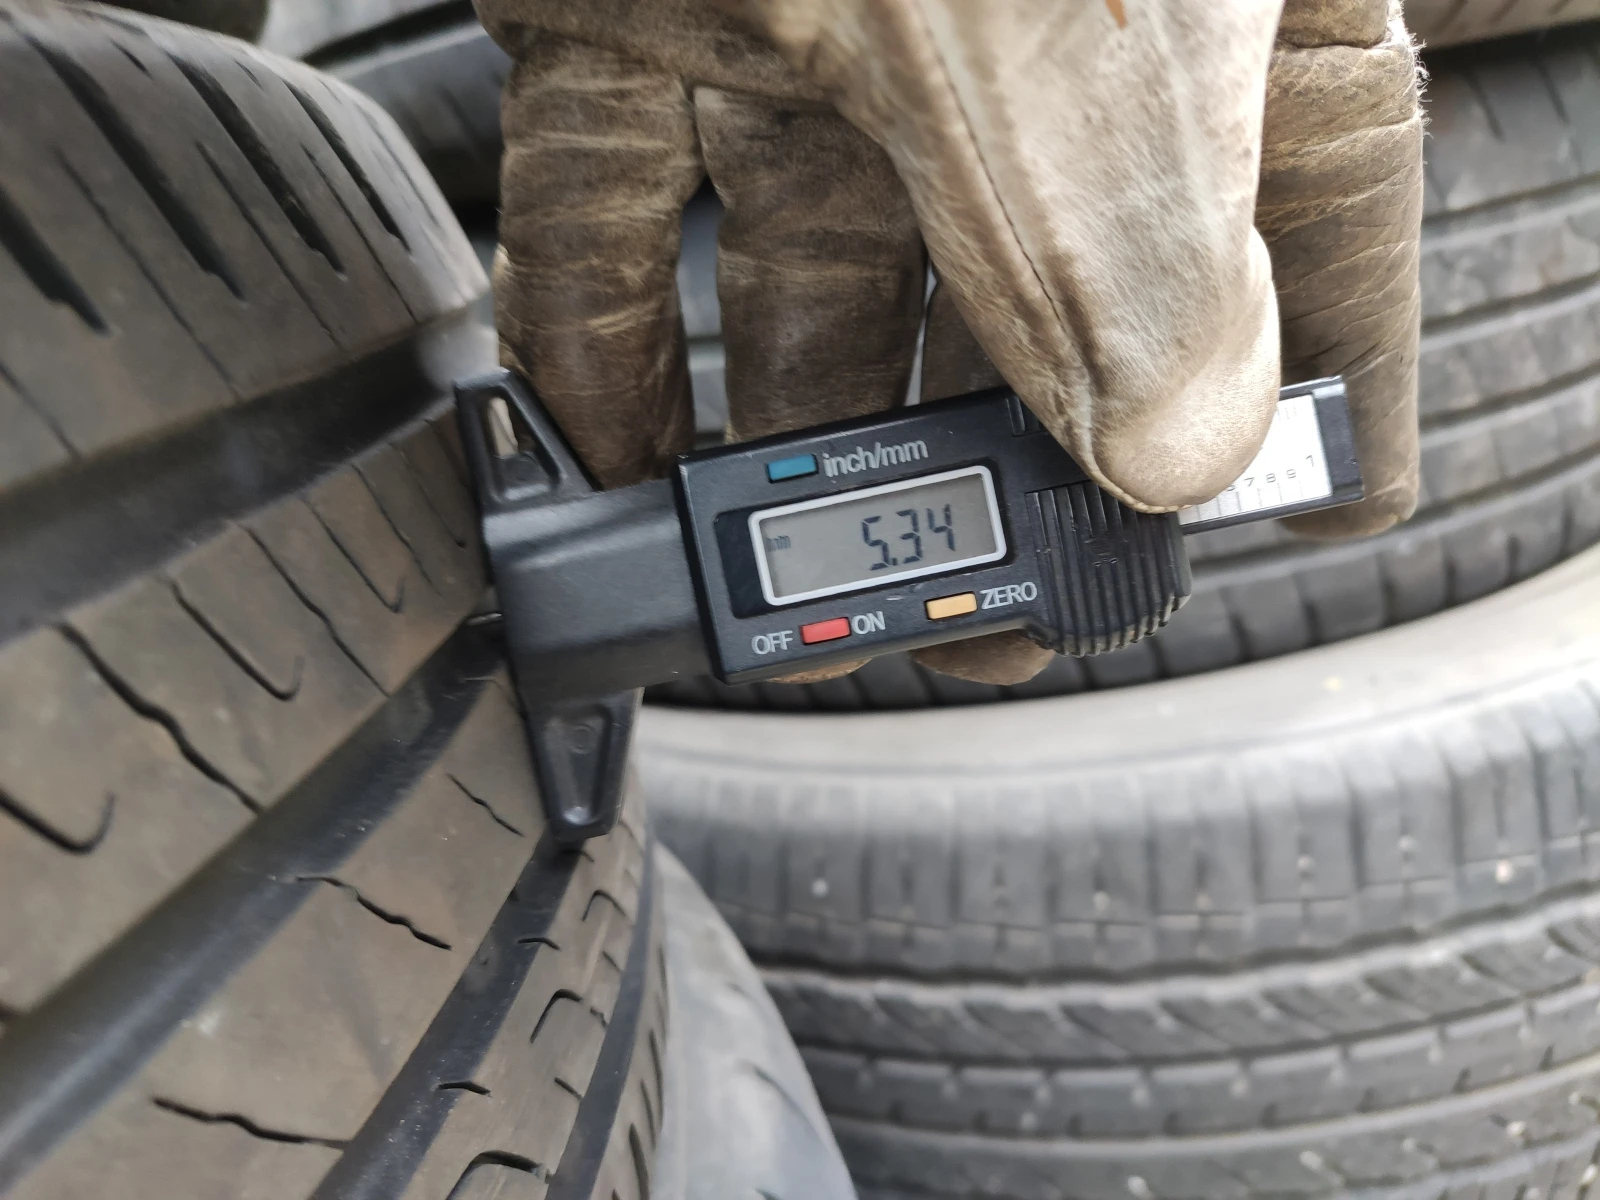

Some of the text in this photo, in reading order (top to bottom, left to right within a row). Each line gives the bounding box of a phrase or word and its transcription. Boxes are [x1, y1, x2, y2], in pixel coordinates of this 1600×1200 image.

[823, 439, 929, 478] inch/mm
[1244, 476, 1255, 487] 7
[1265, 473, 1276, 483] 8
[861, 503, 957, 572] 5.34
[980, 581, 1038, 610] ZERO
[751, 610, 887, 655] OFF ON
